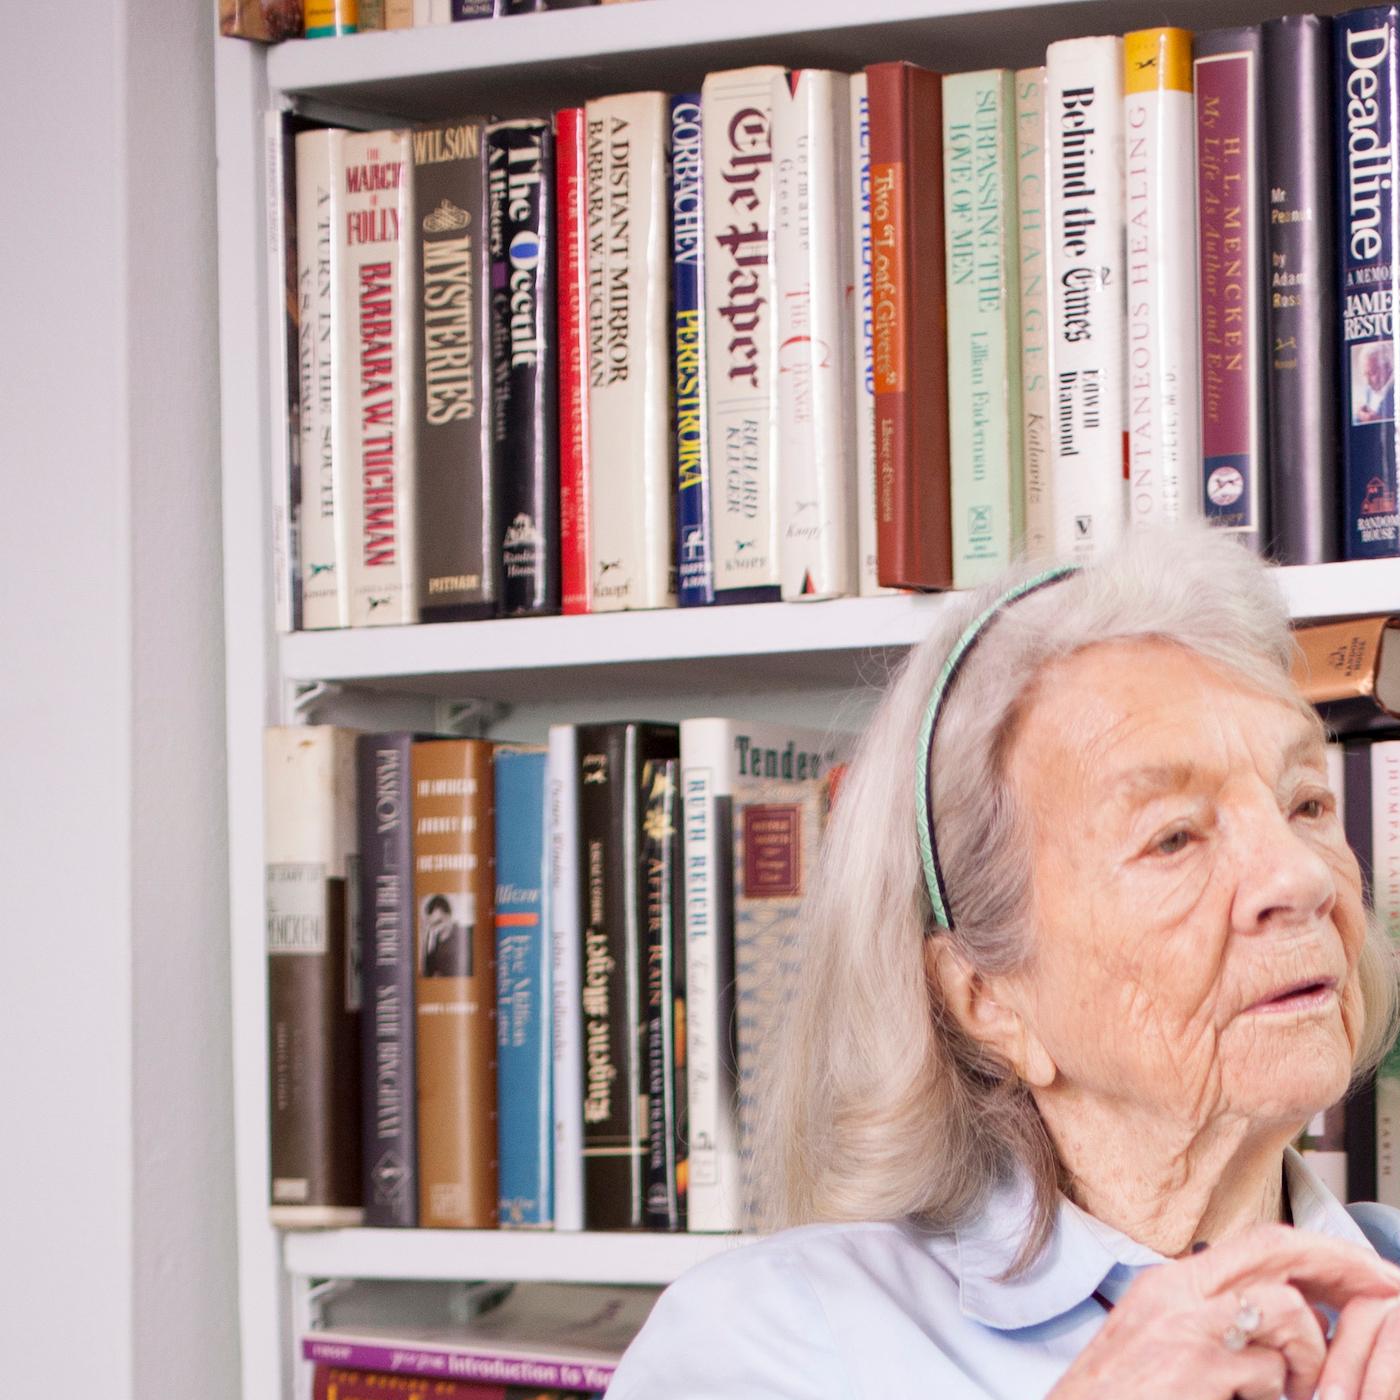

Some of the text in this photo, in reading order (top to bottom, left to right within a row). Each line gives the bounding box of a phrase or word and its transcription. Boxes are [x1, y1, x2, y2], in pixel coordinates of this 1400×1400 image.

[413, 125, 478, 165] WILSON
[507, 136, 545, 368] The Occult
[609, 117, 629, 385] A DISTANT MIRROR
[673, 103, 703, 265] GORBACHEV
[716, 107, 772, 387] The Paper
[948, 123, 973, 285] LOVE OF MEN
[975, 89, 1001, 312] SURPASSING THE
[1060, 87, 1112, 343] Behind the Times
[1127, 107, 1150, 285] HEALING
[1346, 22, 1393, 259] Deadline
[423, 235, 473, 424] MYSTERIES
[588, 121, 605, 387] BARBARA W. TUCHMAN
[1202, 95, 1223, 422] My Life As Author and Editor
[1223, 136, 1242, 373] H. L. MENCKEN
[360, 262, 395, 567] BARBARA W. TUCHMAN
[675, 310, 704, 490] PERESTROIKA
[1060, 372, 1079, 457] Diamond
[688, 780, 706, 841] RUTH
[735, 736, 820, 780] Tender
